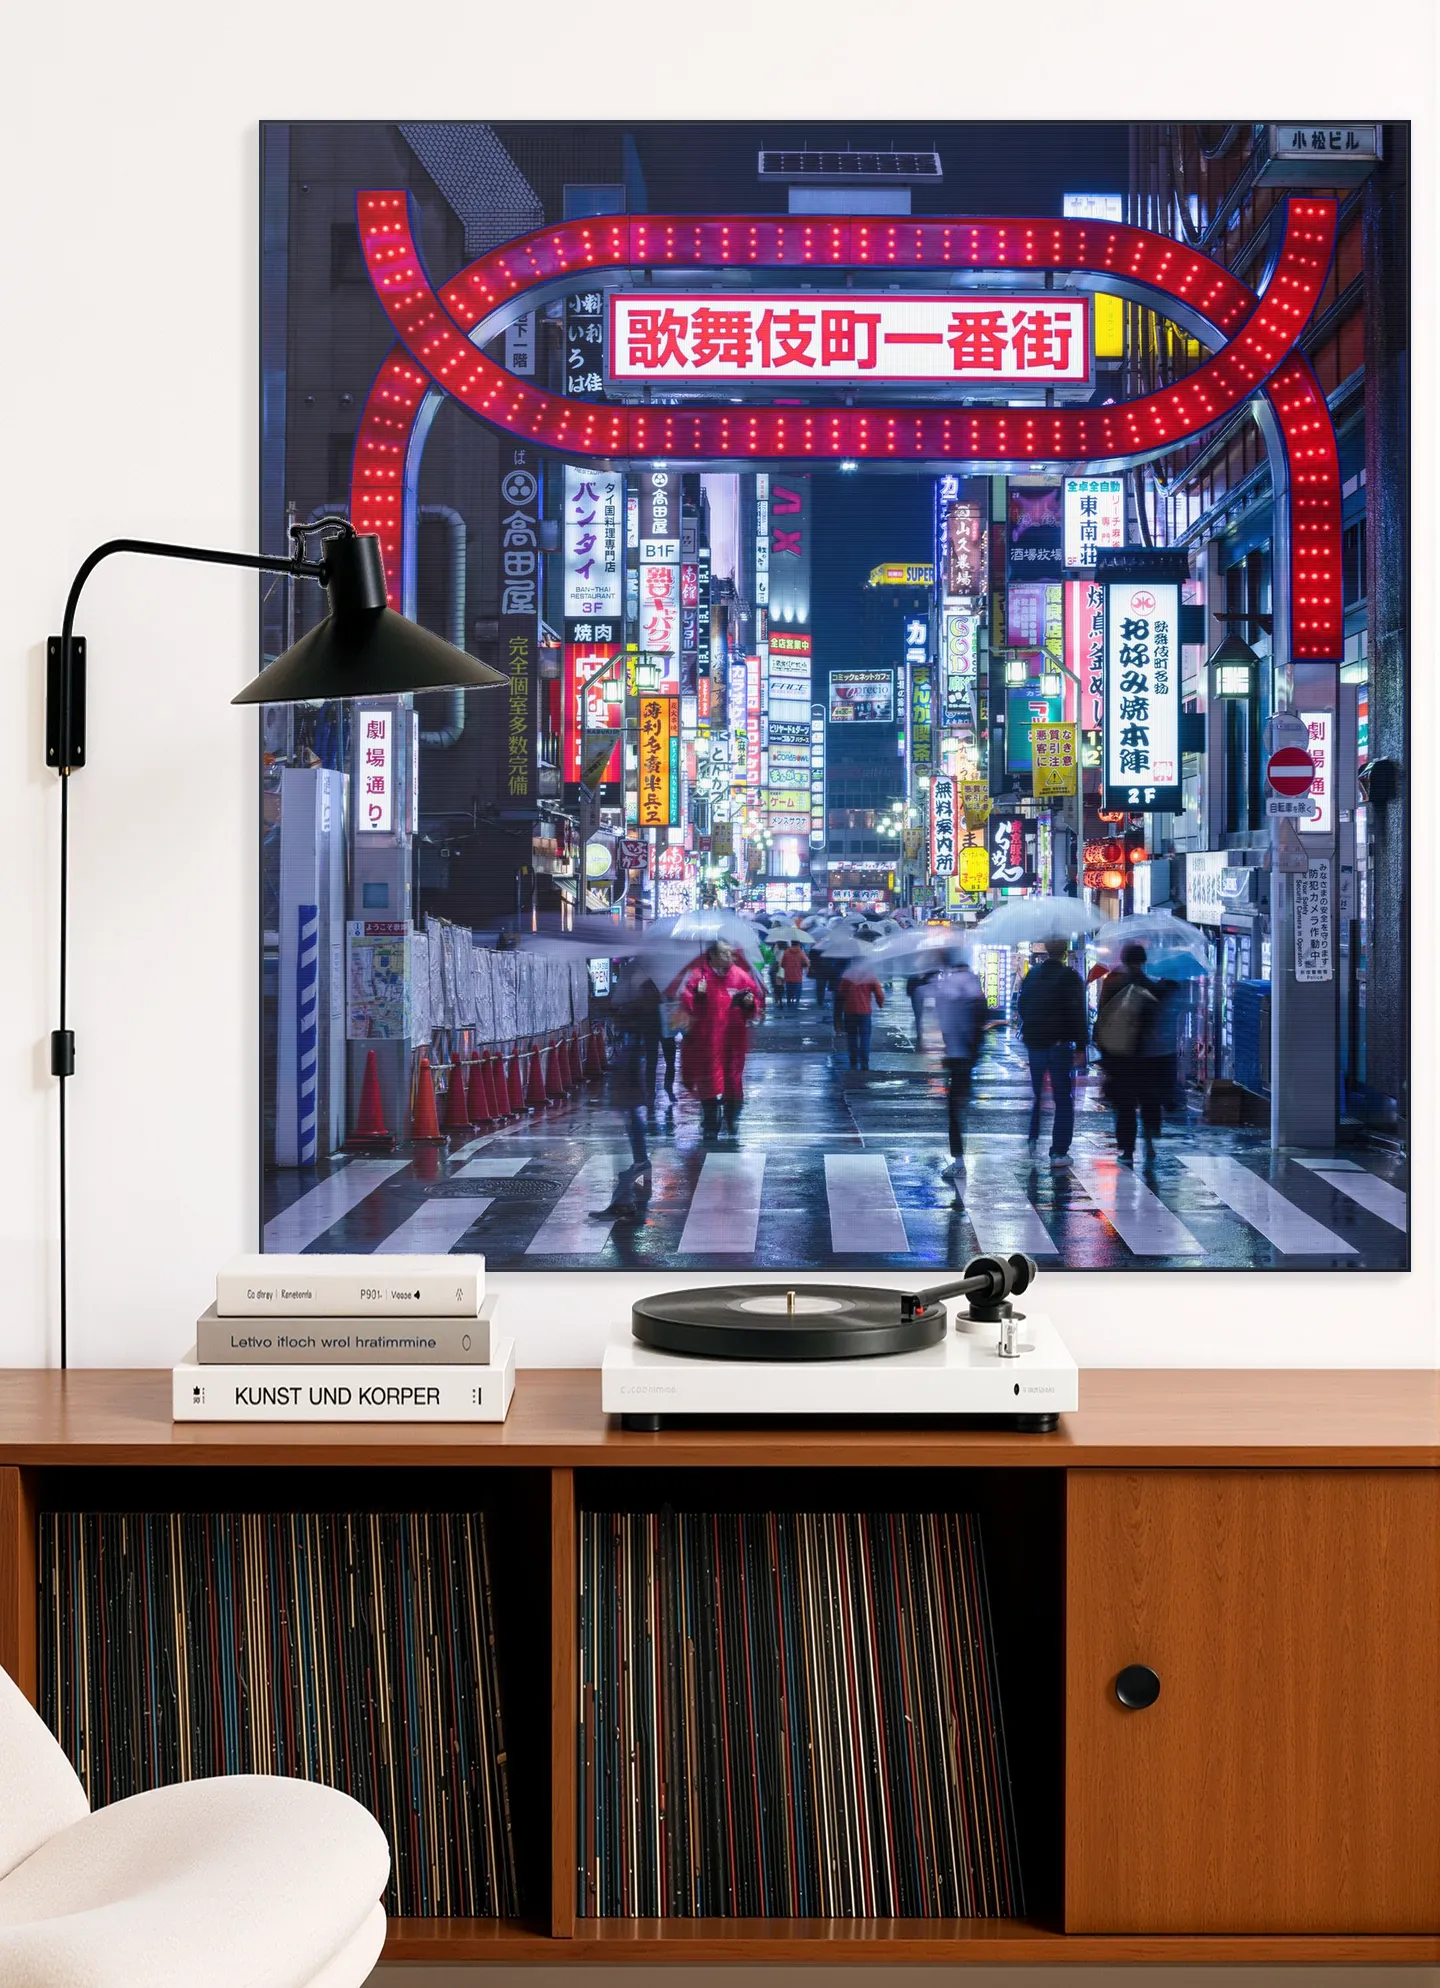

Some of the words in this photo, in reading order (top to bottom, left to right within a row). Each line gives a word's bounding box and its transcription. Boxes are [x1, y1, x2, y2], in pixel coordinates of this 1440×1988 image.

[1292, 130, 1360, 151] 小松ビル
[627, 308, 1072, 371] 歌舞伎町一番街
[1067, 481, 1121, 492] 全卓全自動
[572, 482, 600, 580] バンタイ
[604, 483, 616, 573] タイ国料理専門店
[652, 489, 668, 534] 高田屋
[1080, 495, 1097, 566] 東南荘
[501, 510, 538, 615] 高田屋
[646, 545, 675, 558] B1F
[907, 566, 934, 582] SUPER
[582, 602, 604, 614] 3F
[574, 623, 612, 642] 焼肉
[1153, 620, 1169, 695] 歌舞伎町名物
[508, 636, 528, 796] 完全個室多数完備
[1119, 617, 1150, 774] お好み焼本陣
[1036, 729, 1072, 740] 悪質な
[1036, 743, 1072, 754] 客引き
[366, 720, 385, 822] 劇場通り
[1036, 756, 1073, 767] に注意
[1128, 787, 1156, 804] 2F
[1269, 802, 1312, 814] 自転車を除く
[934, 781, 953, 871] 無料案内所
[1309, 869, 1320, 961] 防犯カメラ作動中
[1319, 863, 1329, 966] みなさまの安全を守ります
[235, 1387, 302, 1405] KUNST
[309, 1387, 352, 1405] UND
[359, 1387, 440, 1405] KORPER
